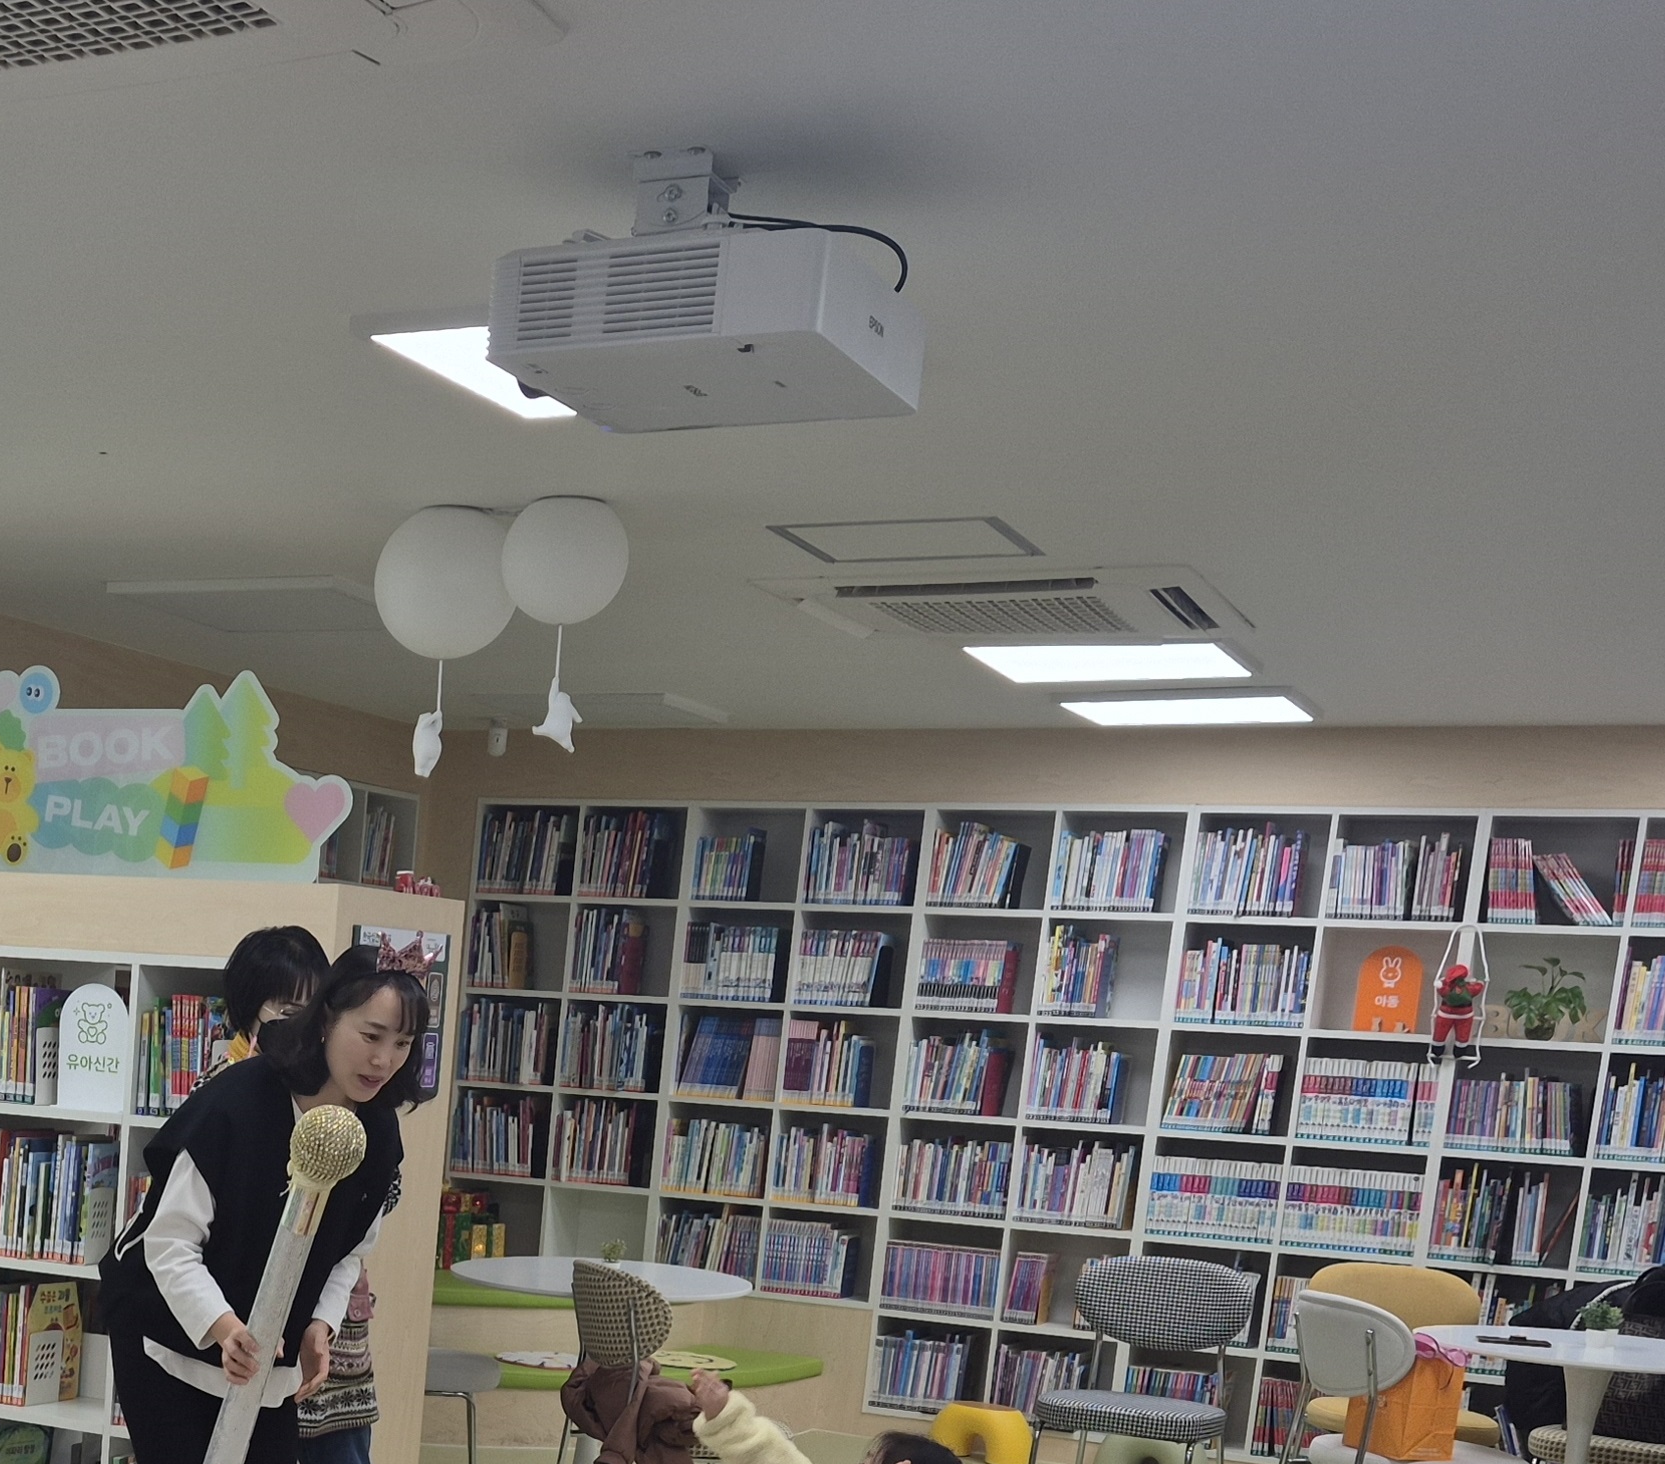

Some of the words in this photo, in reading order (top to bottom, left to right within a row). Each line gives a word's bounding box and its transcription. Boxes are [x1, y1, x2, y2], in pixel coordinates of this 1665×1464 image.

[39, 723, 173, 769] BOOK
[44, 794, 151, 837] PLAY
[1375, 994, 1400, 1008] 아동
[66, 1054, 120, 1074] 유아신간
